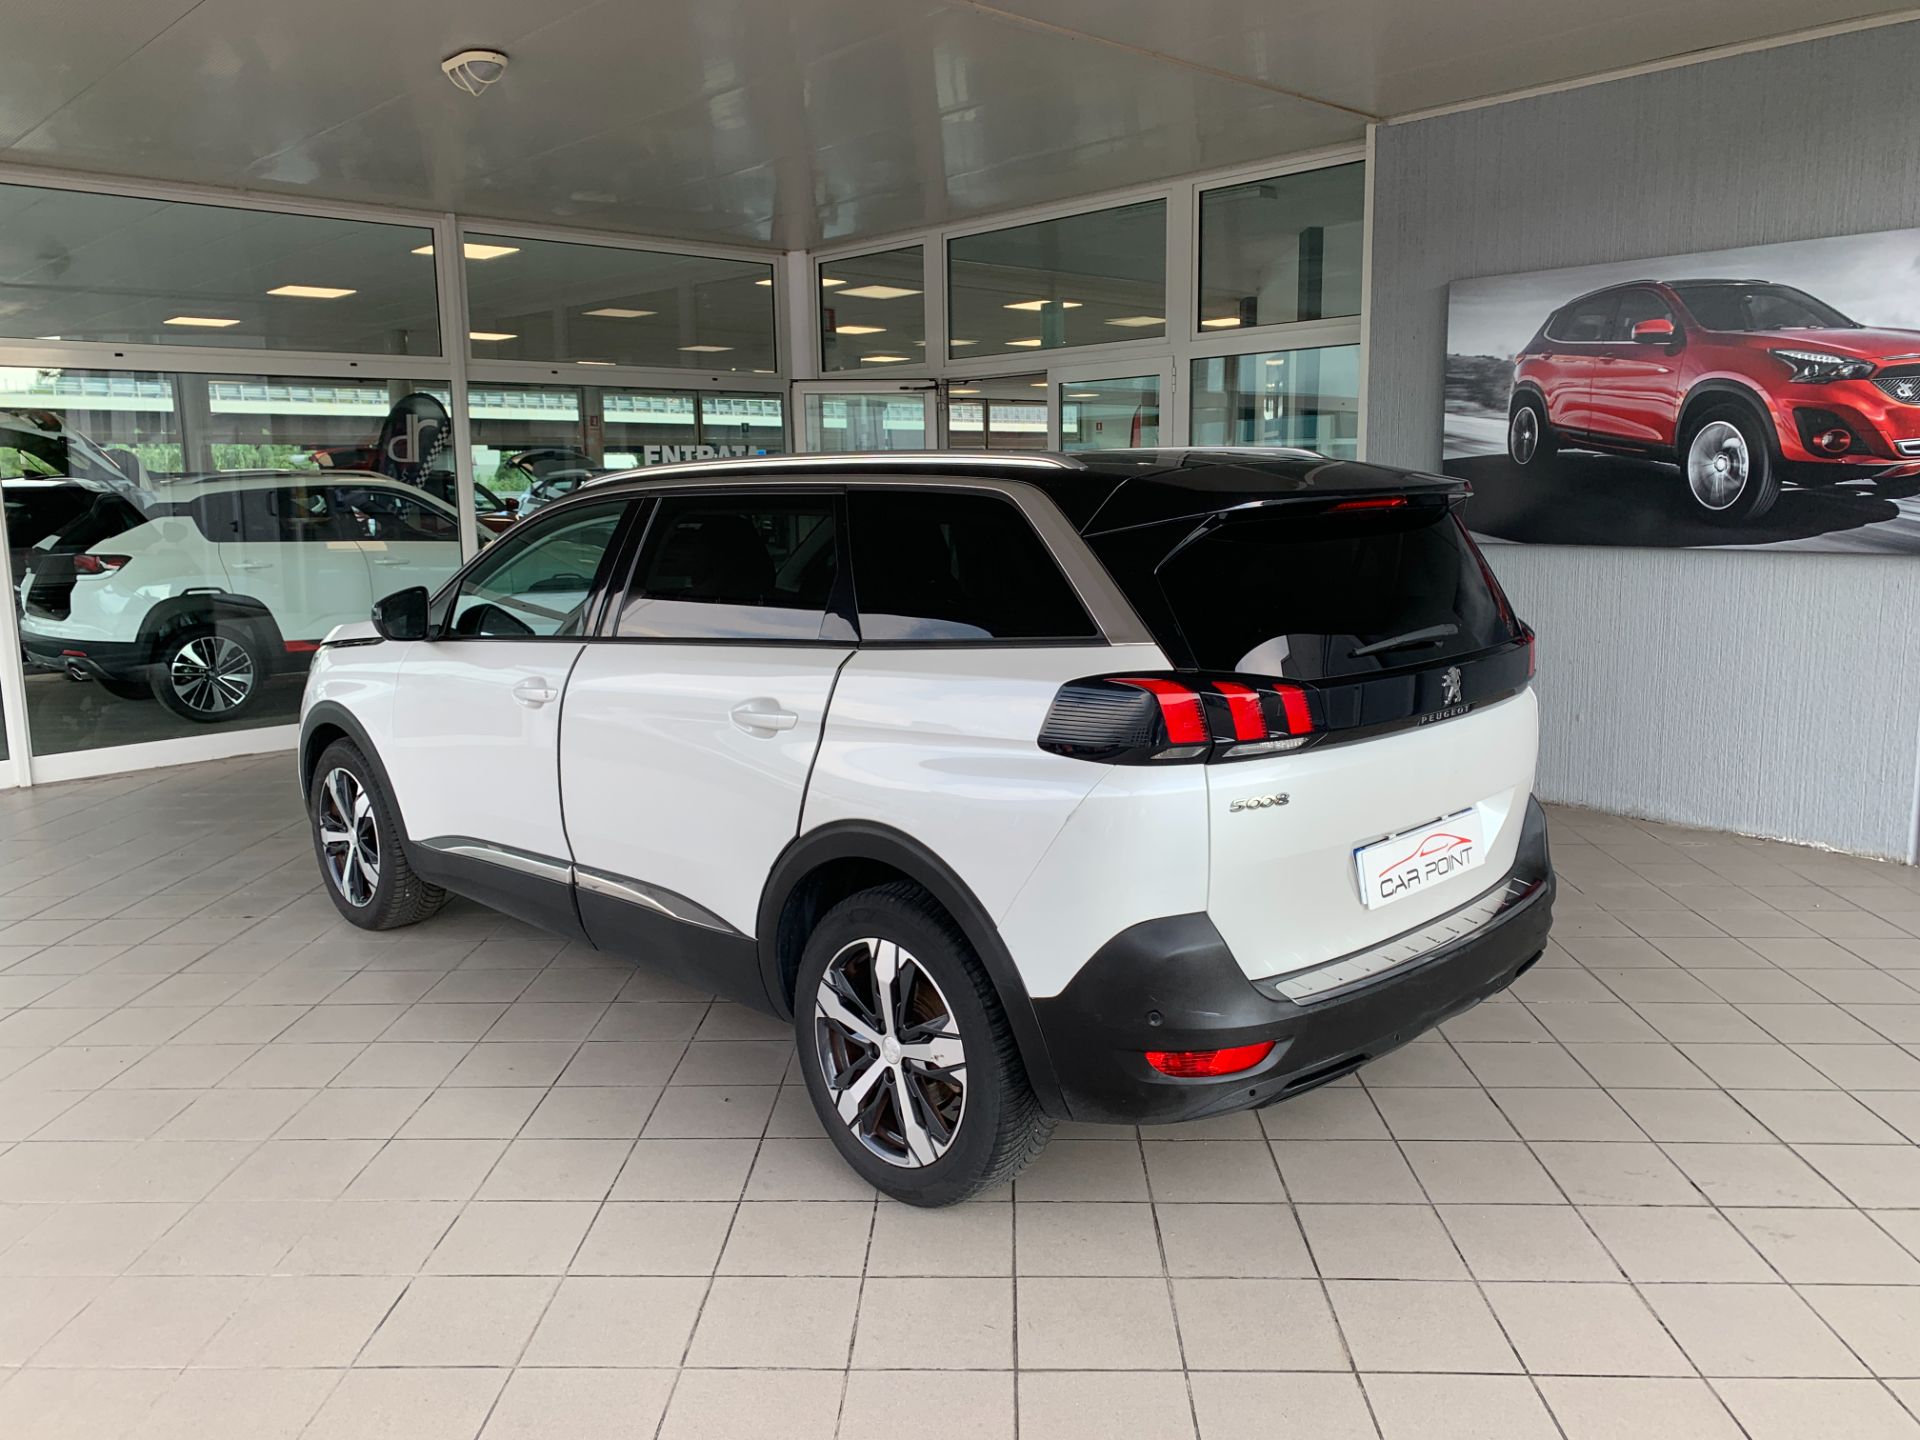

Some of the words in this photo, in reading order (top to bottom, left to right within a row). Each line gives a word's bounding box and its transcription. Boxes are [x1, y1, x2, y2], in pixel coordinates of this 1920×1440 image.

[387, 414, 438, 463] dr
[1421, 705, 1470, 724] PEUGEOT
[1229, 792, 1290, 813] 5008
[1379, 868, 1421, 899] CAR
[1425, 847, 1473, 881] POINT
